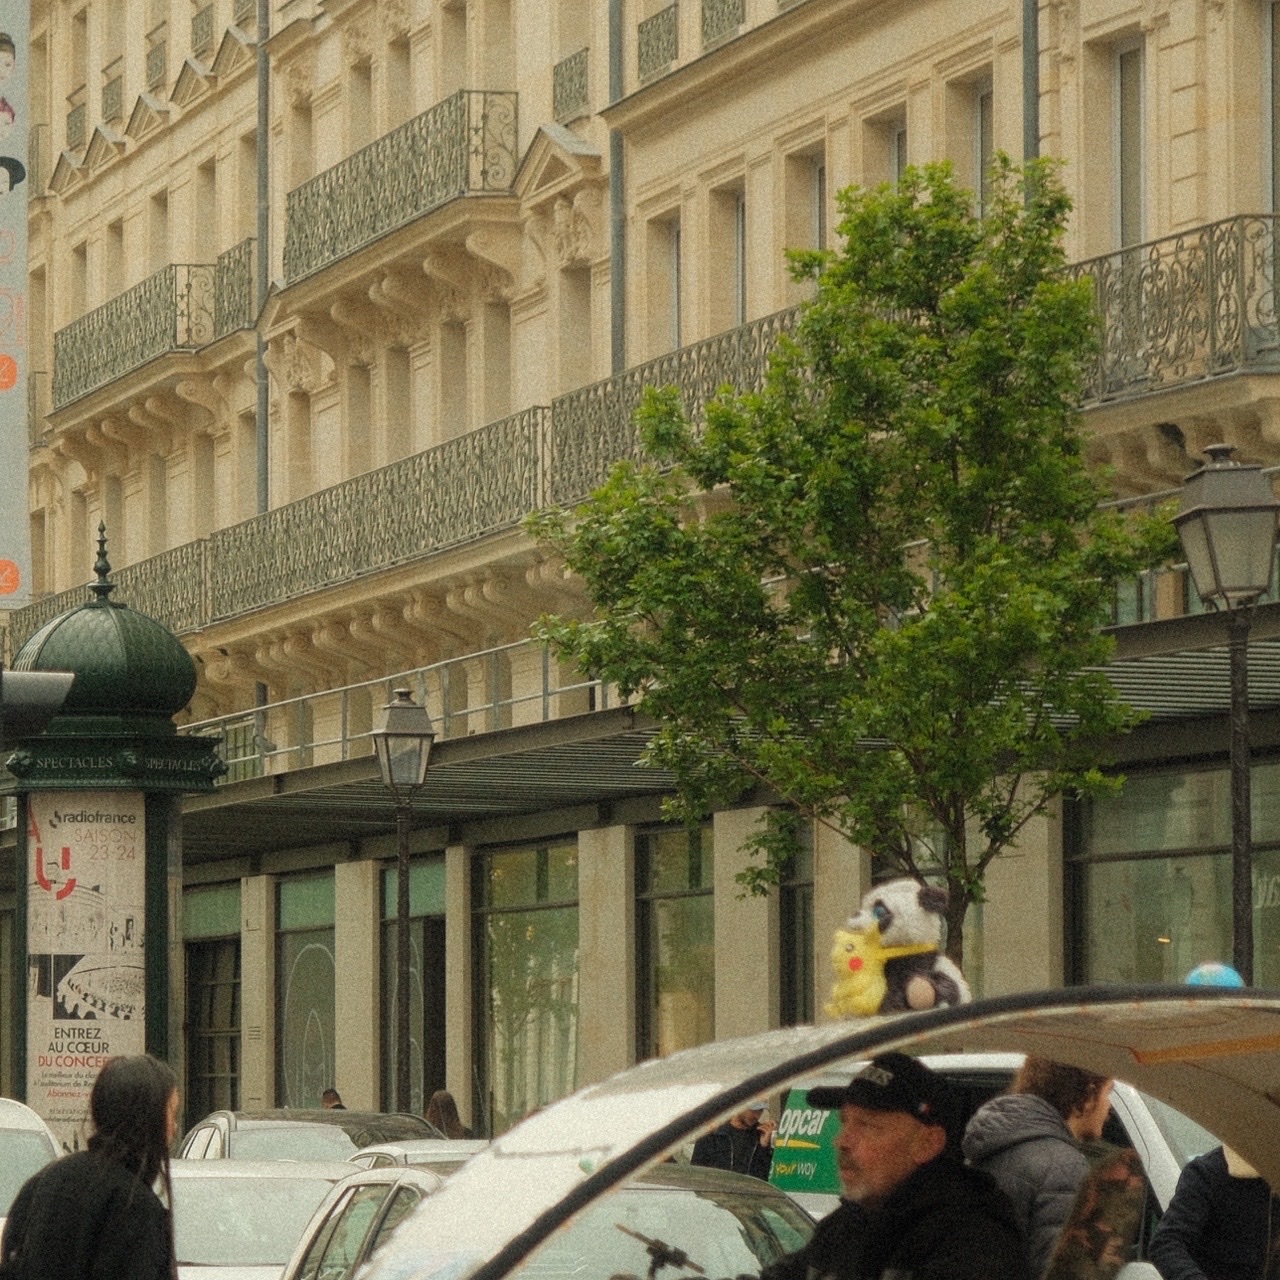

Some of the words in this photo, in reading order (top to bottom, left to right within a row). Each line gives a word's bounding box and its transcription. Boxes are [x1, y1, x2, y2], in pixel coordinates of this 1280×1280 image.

[36, 756, 113, 769] SPECTACLES
[63, 810, 137, 824] radiofrance
[74, 828, 137, 843] SAISON
[54, 1027, 101, 1039] ENTREZ
[48, 1041, 64, 1053] AU
[66, 1041, 110, 1053] CŒUR
[38, 1055, 53, 1067] DU
[797, 1163, 817, 1180] way
